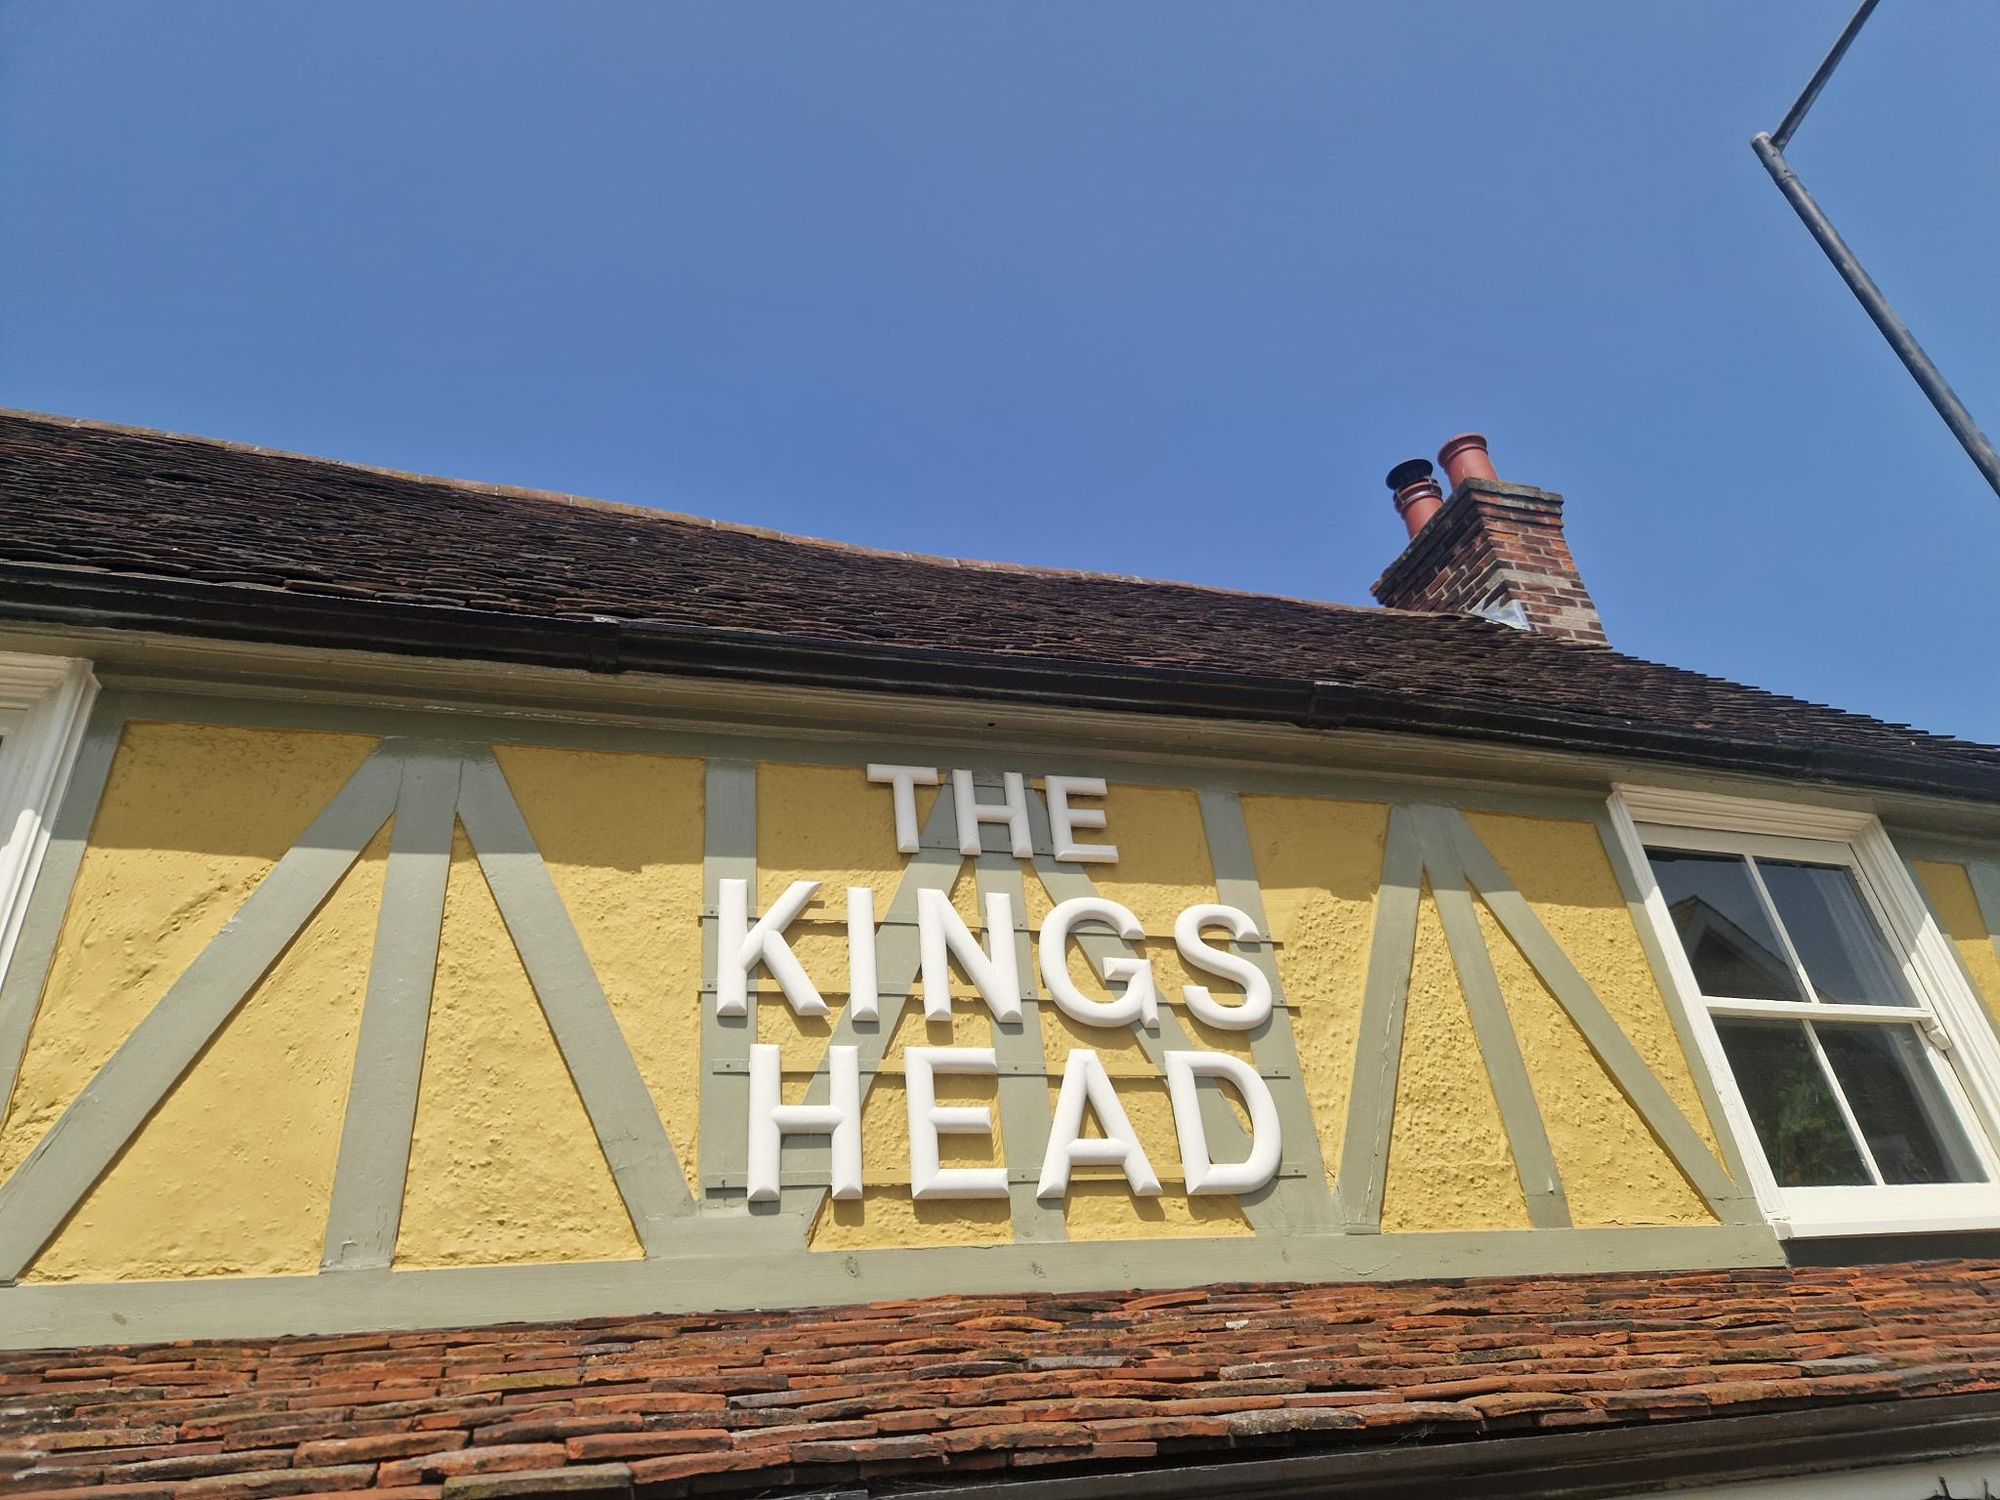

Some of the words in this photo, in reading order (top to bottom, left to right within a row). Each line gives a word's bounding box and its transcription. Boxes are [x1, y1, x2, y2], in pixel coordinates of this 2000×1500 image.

[867, 763, 1119, 863] THE
[716, 878, 1273, 1030] KINGS
[746, 1043, 1281, 1202] HEAD
